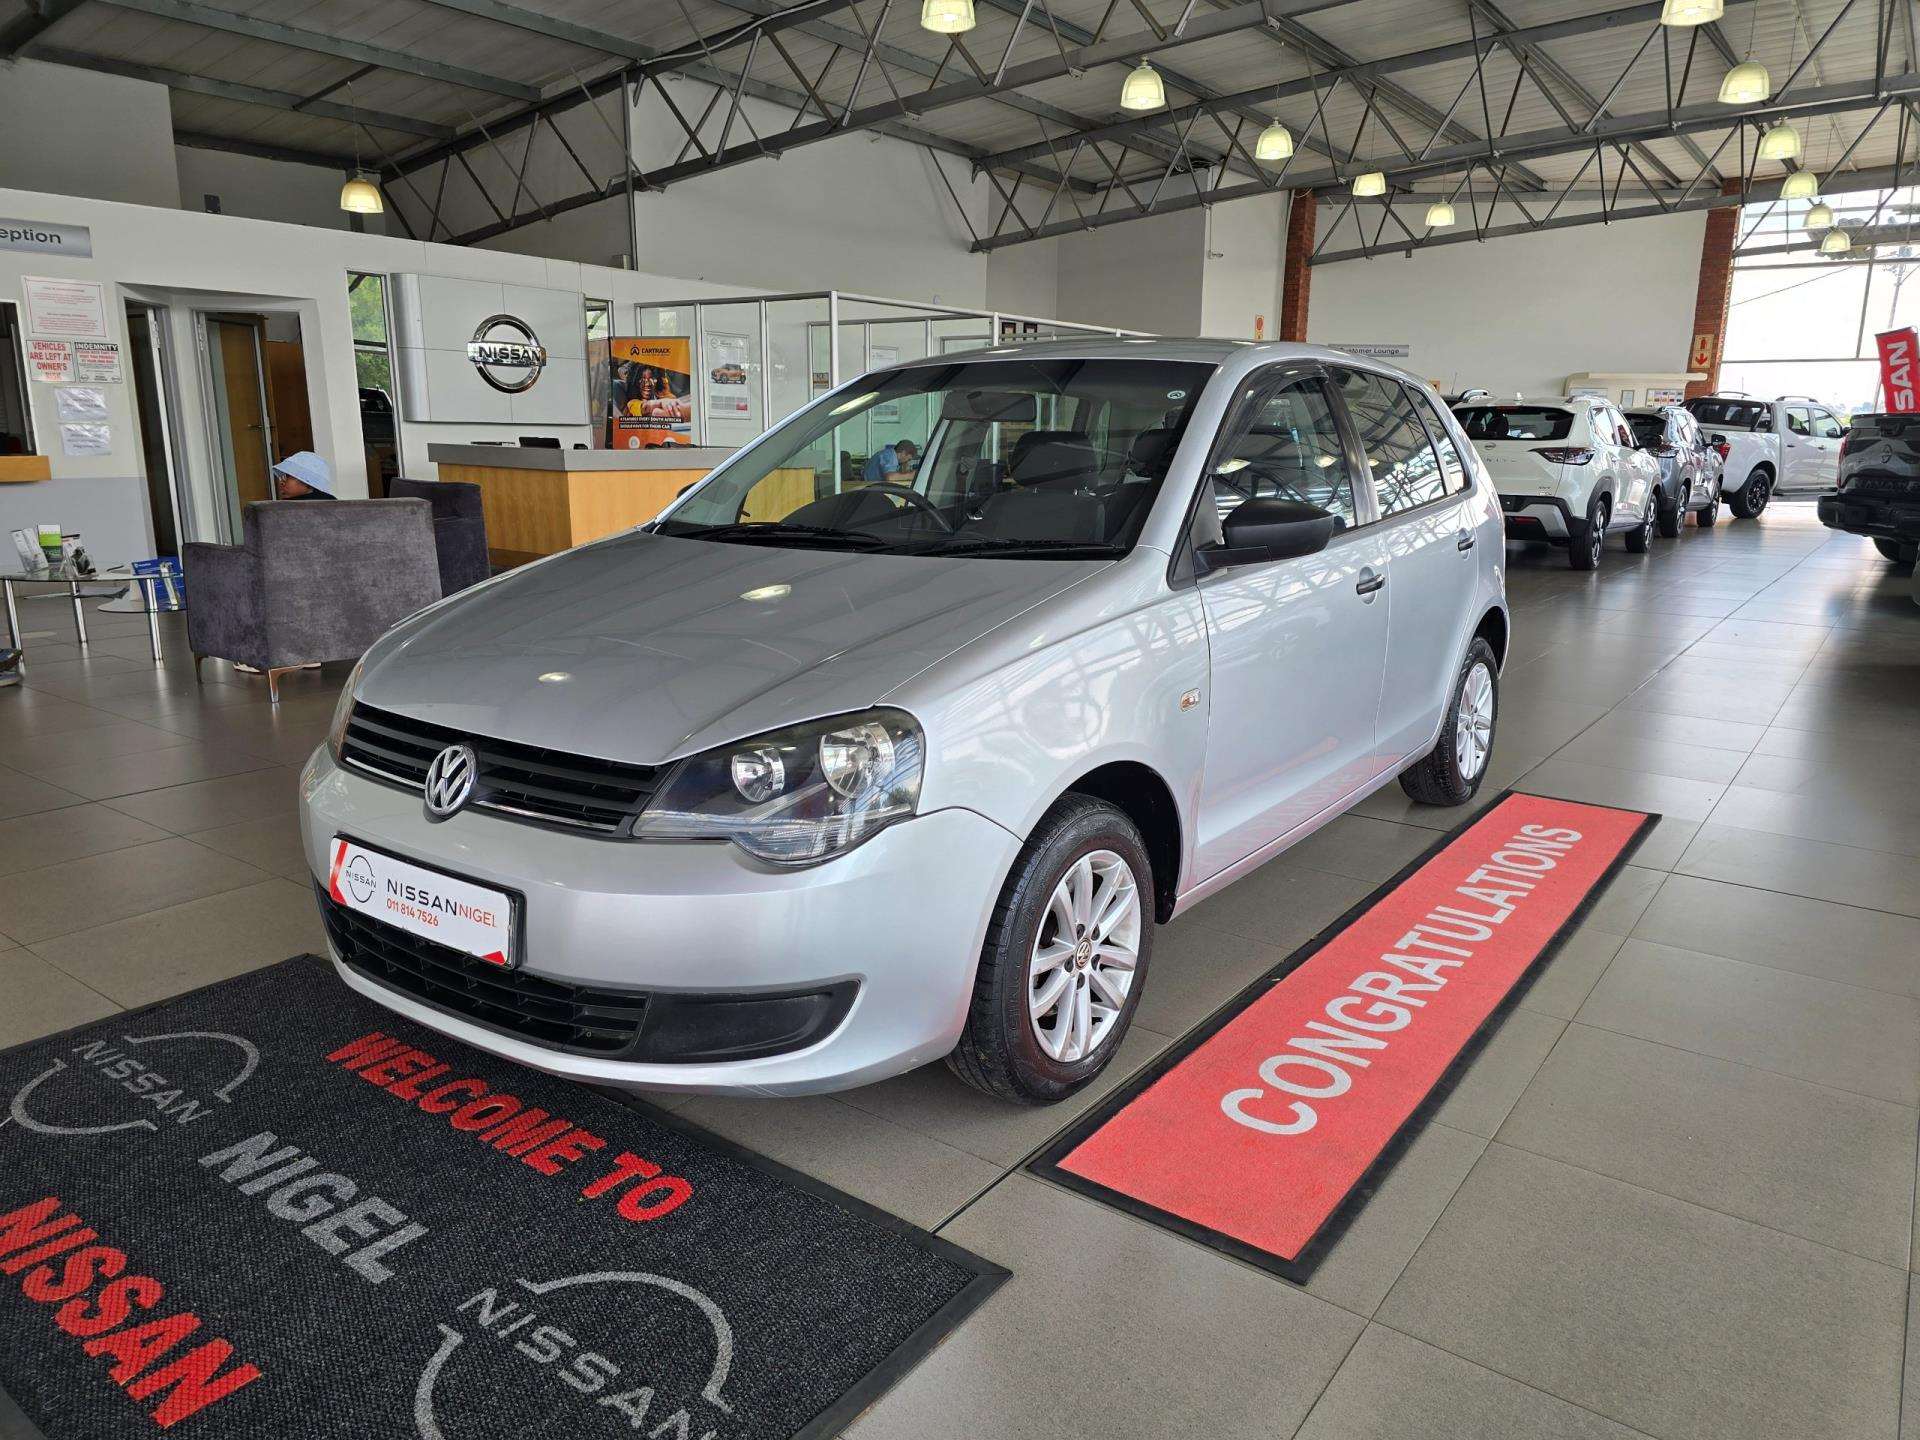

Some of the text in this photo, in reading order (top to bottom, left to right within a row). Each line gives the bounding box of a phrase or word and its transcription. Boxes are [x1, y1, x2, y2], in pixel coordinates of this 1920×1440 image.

[32, 342, 66, 351] VEHICLES
[75, 343, 118, 351] INDEMNITY
[478, 345, 541, 361] NISSAN
[1373, 348, 1400, 356] Lounge
[29, 352, 44, 360] ARE
[45, 352, 61, 361] LEFT
[63, 353, 72, 361] AT
[37, 362, 67, 371] OWNER'S
[346, 870, 376, 889] NISSAN
[386, 898, 439, 927] 011 814 7526
[1220, 824, 1582, 1135] CONGRATULATIONS
[72, 1040, 214, 1125] NISSAN
[324, 1031, 693, 1222] WELCOME TO
[198, 1130, 429, 1284] NIGEL
[0, 1196, 262, 1428] NISSAN
